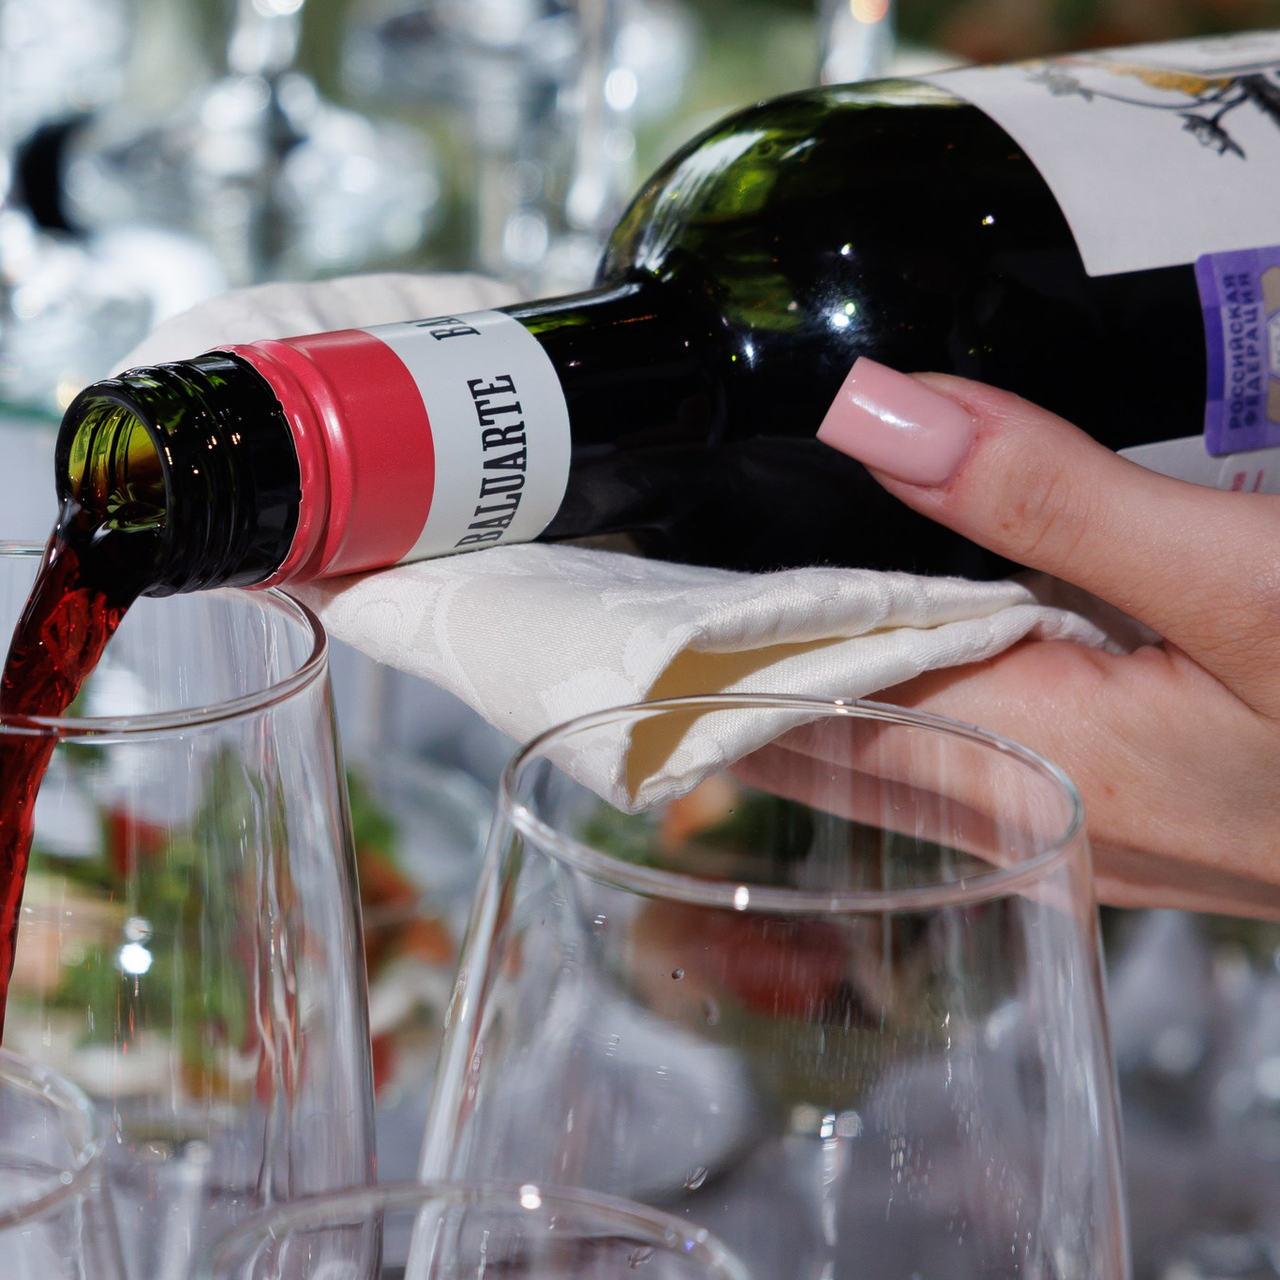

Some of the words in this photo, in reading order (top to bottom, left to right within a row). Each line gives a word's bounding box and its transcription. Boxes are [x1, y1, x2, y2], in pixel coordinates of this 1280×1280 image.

[1223, 274, 1245, 429] РОССИЙСКАЯ
[1237, 273, 1260, 428] ФЕДЕРАЦИЯ
[454, 374, 527, 549] BALUARTE
